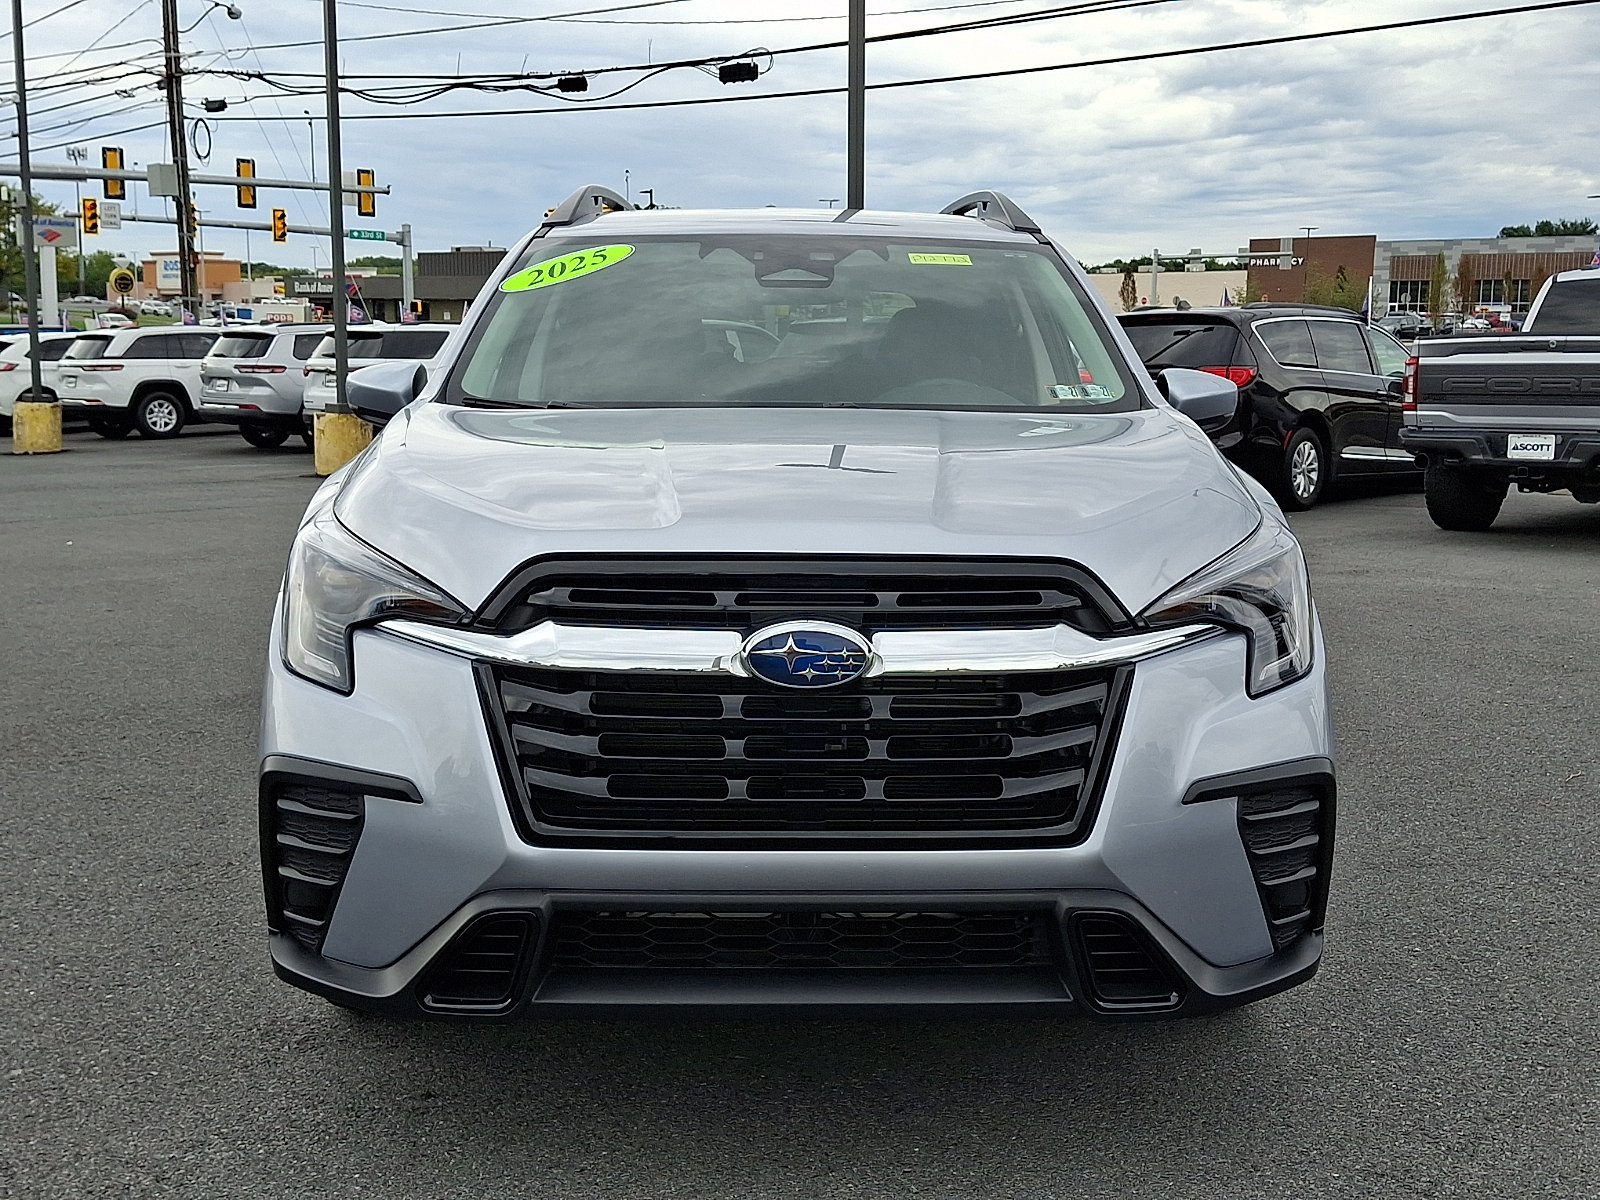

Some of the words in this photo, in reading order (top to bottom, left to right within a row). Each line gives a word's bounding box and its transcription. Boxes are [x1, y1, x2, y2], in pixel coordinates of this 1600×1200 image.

[361, 231, 374, 239] 33rd
[163, 260, 181, 271] ROS
[1250, 257, 1304, 266] PHARCY
[528, 248, 607, 287] 2025
[294, 281, 311, 293] Bank
[267, 313, 293, 322] PODS
